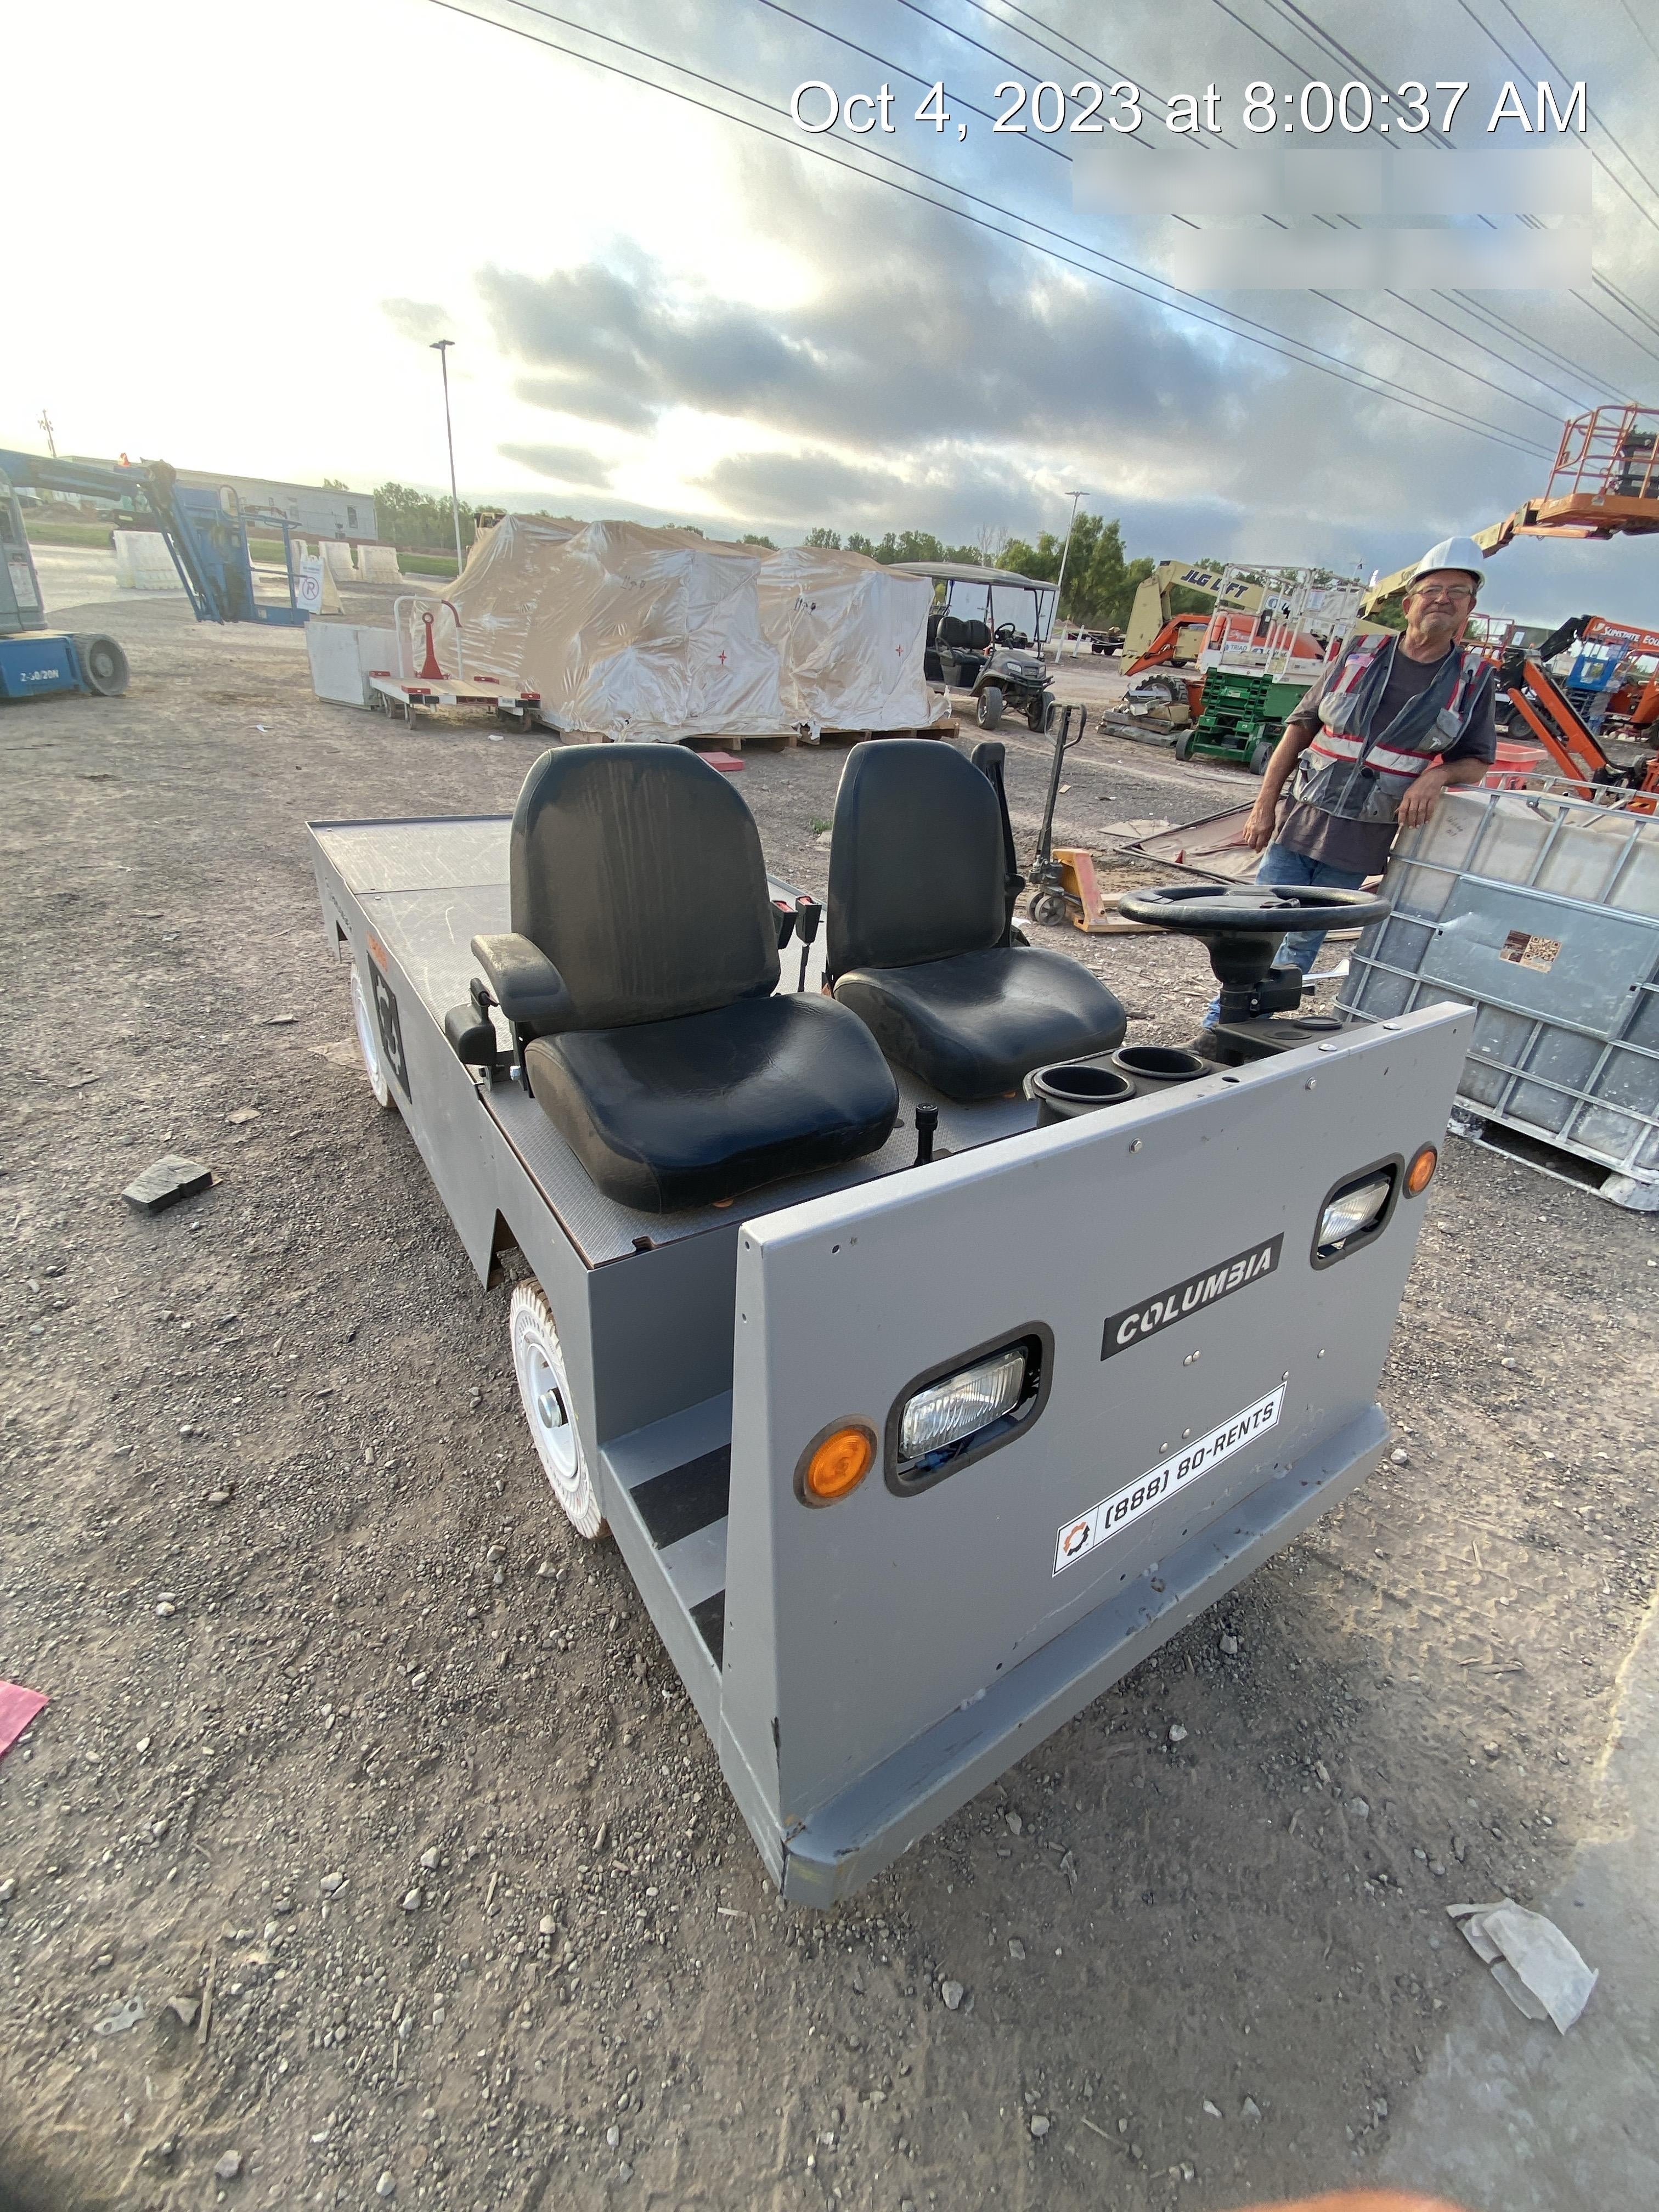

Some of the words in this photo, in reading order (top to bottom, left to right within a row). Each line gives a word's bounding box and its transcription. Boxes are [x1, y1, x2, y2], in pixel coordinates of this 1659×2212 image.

[1180, 569, 1212, 587] JLG
[1210, 578, 1249, 598] LFT
[1116, 1247, 1272, 1345] COLUMBIA
[1104, 1469, 1169, 1529] (888)
[1176, 1401, 1274, 1480] 80-RENTS
